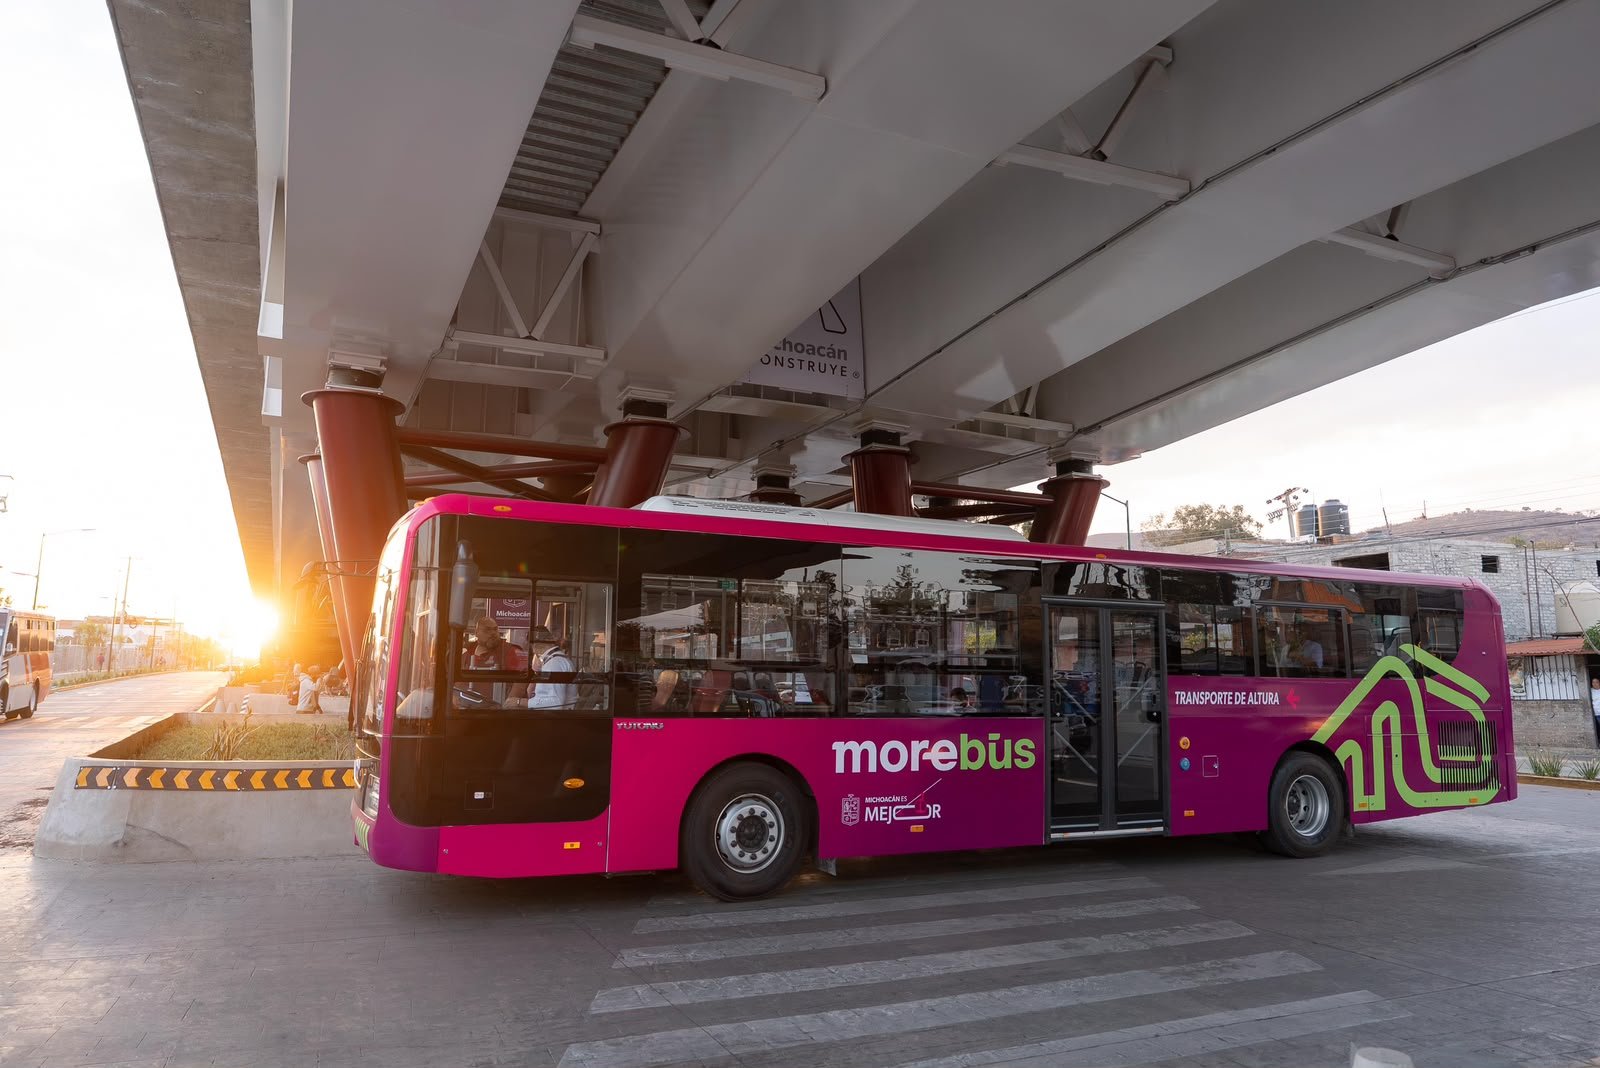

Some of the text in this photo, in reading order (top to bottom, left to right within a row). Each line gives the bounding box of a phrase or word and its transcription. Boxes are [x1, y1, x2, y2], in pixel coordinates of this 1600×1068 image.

[760, 354, 847, 377] ONSTRUYE
[1175, 691, 1279, 705] TRANSPORTE DE ALTURA
[864, 795, 900, 803] MICHOACÁN
